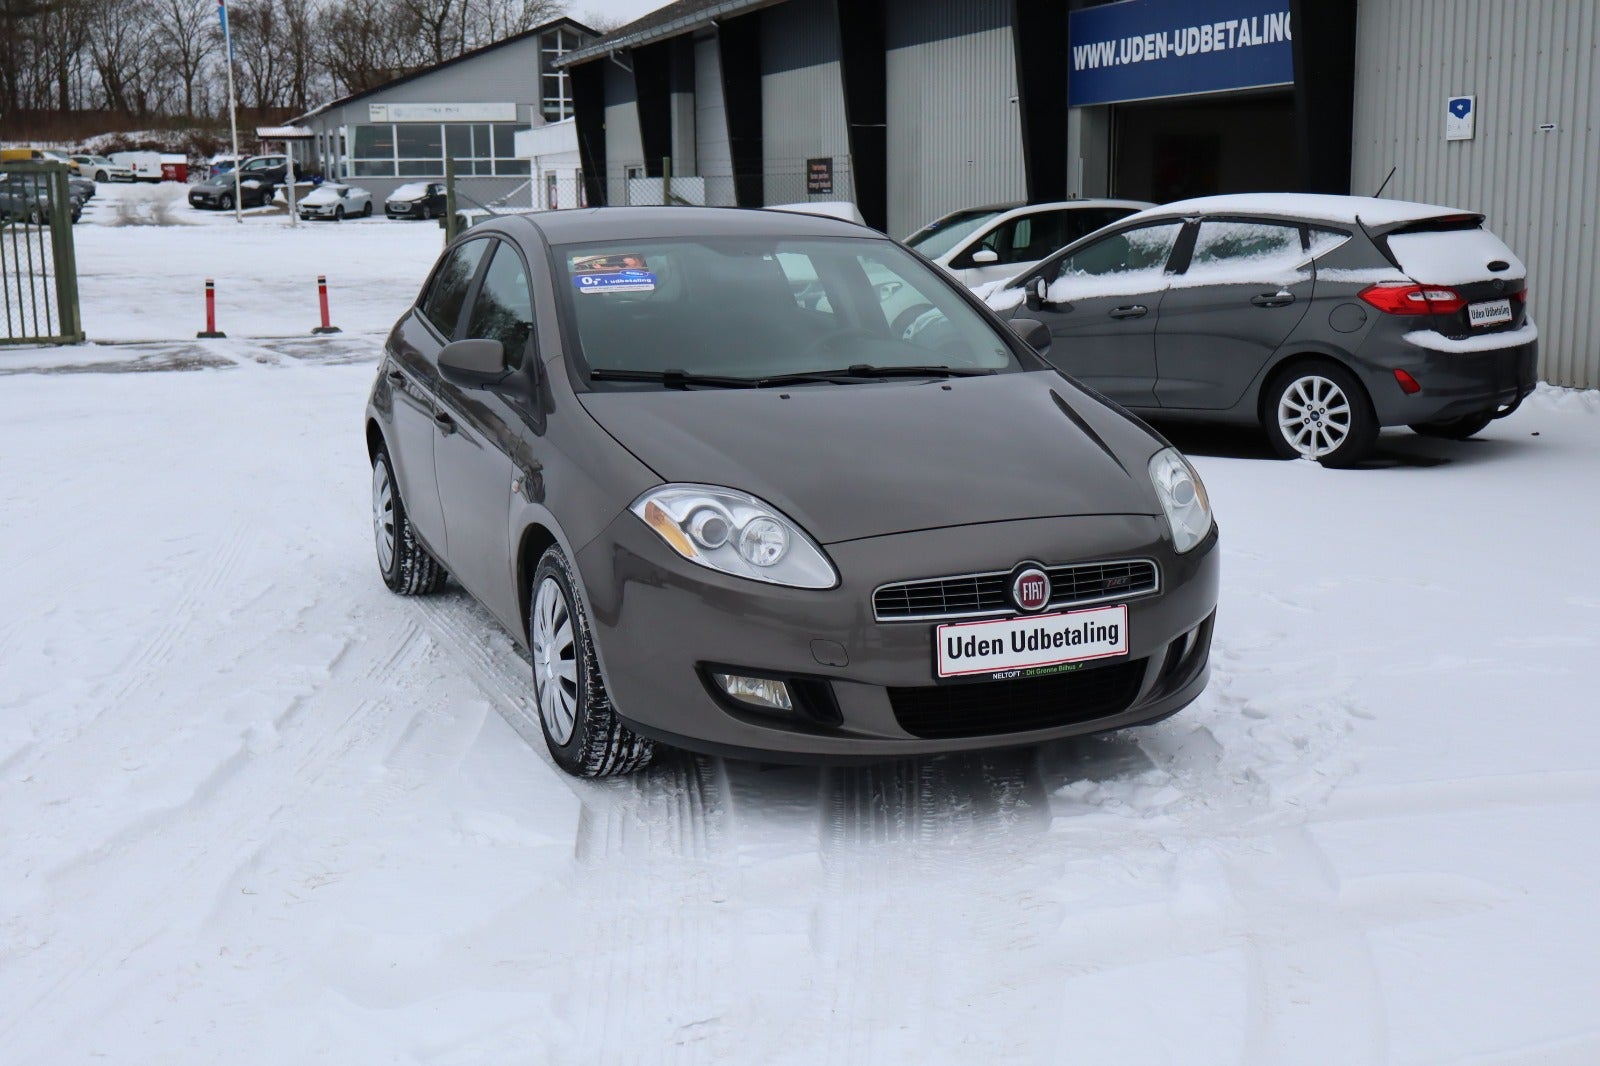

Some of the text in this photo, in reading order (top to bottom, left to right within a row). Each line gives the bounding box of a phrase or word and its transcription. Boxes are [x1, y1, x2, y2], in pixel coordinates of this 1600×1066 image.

[1022, 581, 1044, 601] FIAT
[947, 621, 1119, 660] Uden Udbetaling
[992, 670, 1020, 679] NELTOFT
